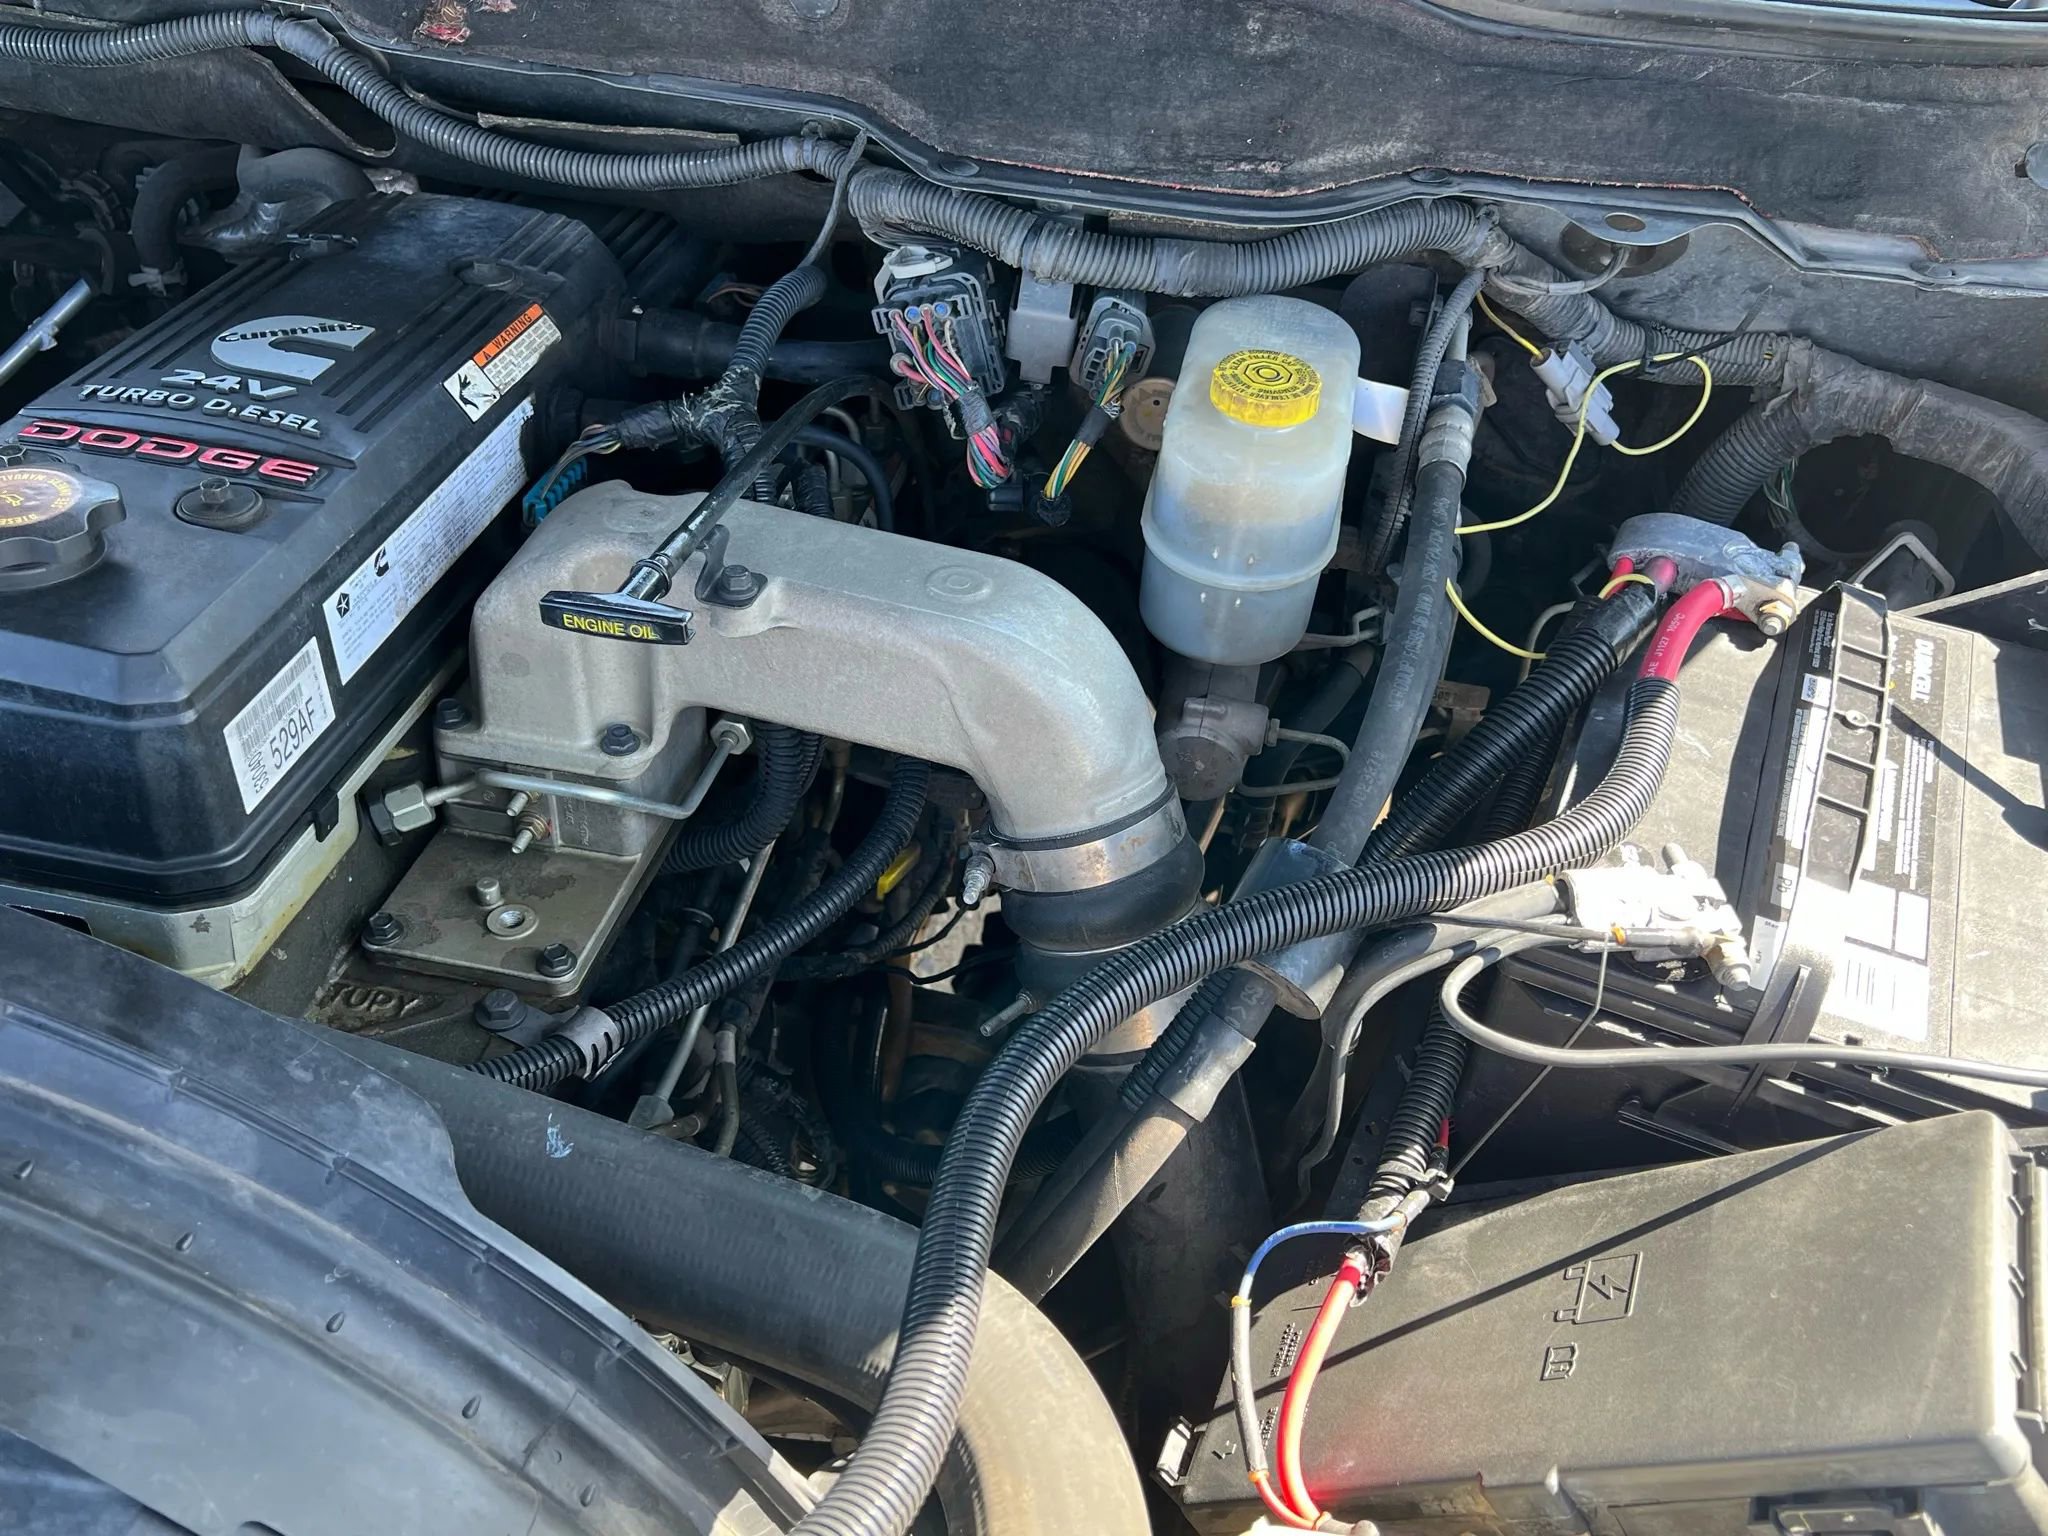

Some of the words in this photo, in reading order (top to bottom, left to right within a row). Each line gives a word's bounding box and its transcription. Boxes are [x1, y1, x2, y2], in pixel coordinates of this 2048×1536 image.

[218, 322, 364, 342] Cummins
[492, 313, 533, 350] WARNING
[160, 368, 298, 401] 24V
[78, 384, 196, 411] TURBO
[202, 398, 321, 439] DIESEL
[17, 420, 320, 488] DODGE
[562, 613, 626, 636] ENGINE
[629, 624, 658, 639] OIL
[1910, 638, 1935, 701] DURACELL
[269, 697, 317, 770] 529AF
[1776, 876, 1793, 893] Pb
